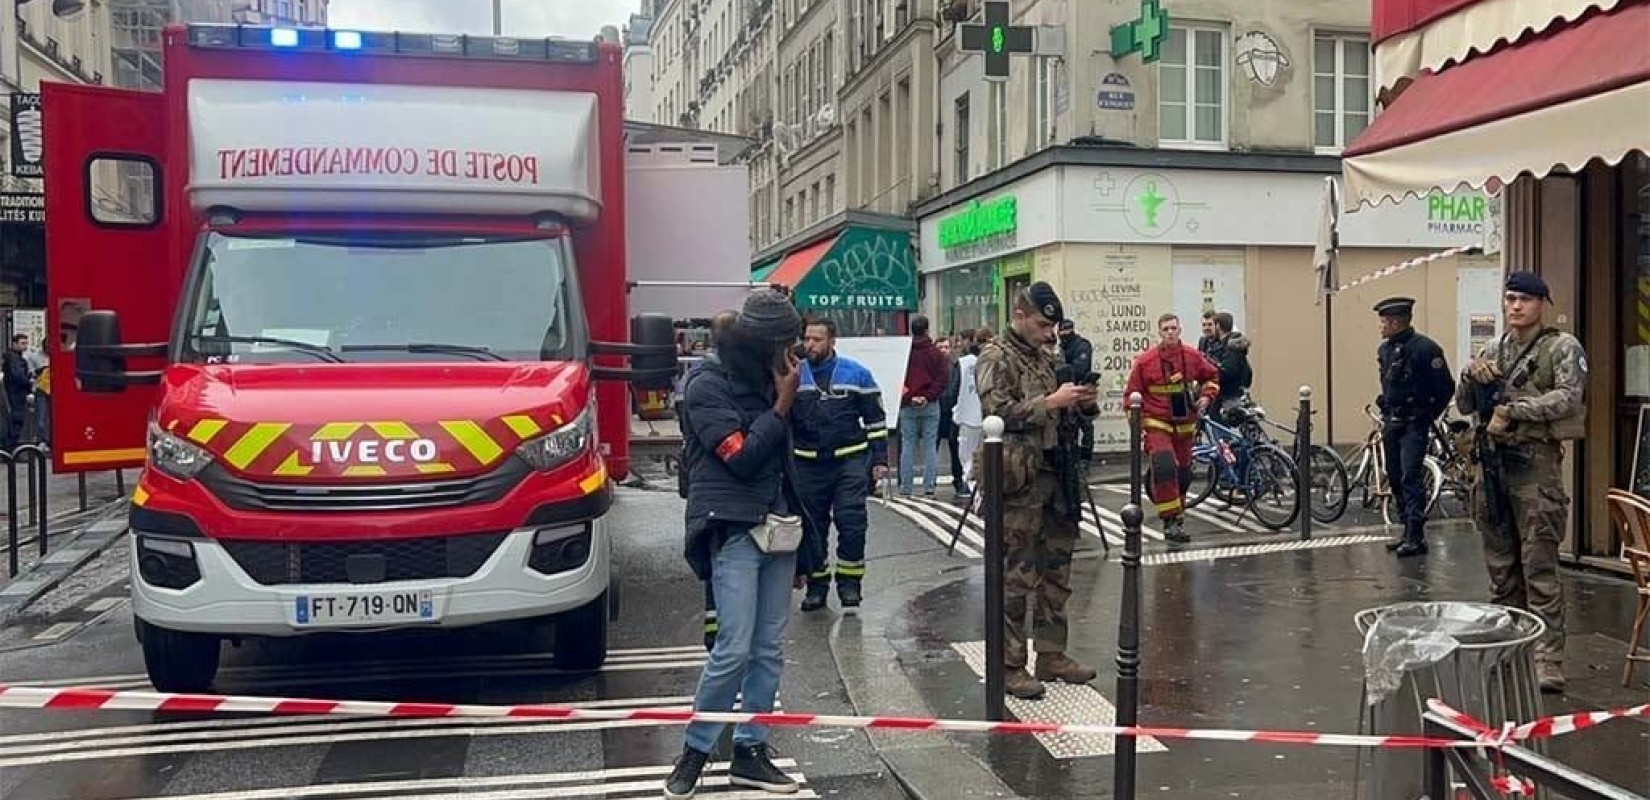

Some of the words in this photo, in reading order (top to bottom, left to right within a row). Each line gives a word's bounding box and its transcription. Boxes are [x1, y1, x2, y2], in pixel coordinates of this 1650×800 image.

[1428, 196, 1484, 221] PHAR
[808, 295, 839, 306] TOP
[847, 295, 903, 306] FRUITS
[1111, 304, 1146, 317] LUNDI
[1106, 320, 1151, 333] SAMEDI
[1113, 337, 1150, 352] 8h30
[1104, 356, 1137, 370] 20h
[311, 439, 437, 463] IVECO
